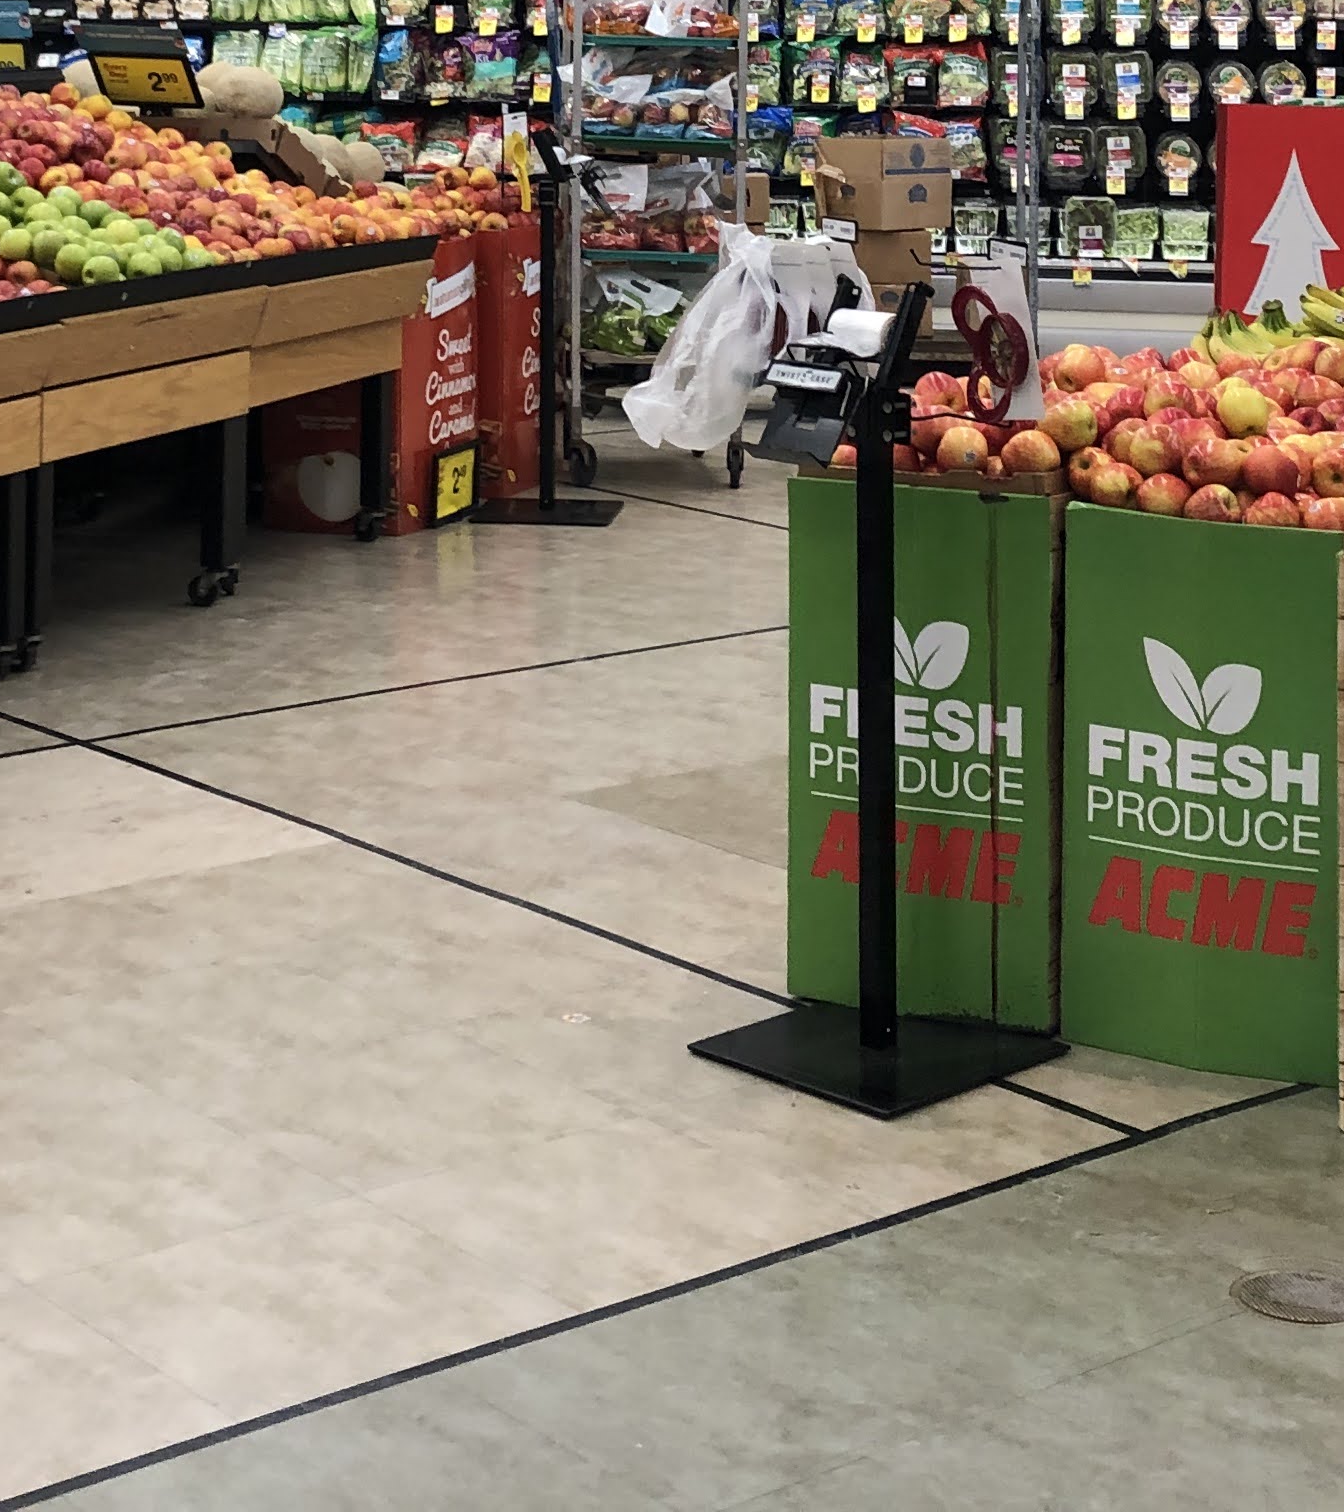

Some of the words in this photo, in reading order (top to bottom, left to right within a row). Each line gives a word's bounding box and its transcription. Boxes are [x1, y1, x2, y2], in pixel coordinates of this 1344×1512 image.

[809, 682, 1023, 758] FESH
[809, 742, 1025, 808] PRDUCE
[1087, 723, 1320, 807] FRESH
[810, 808, 1024, 907] AME
[1087, 785, 1321, 857] PRODUCE
[1088, 855, 1318, 958] ACME
